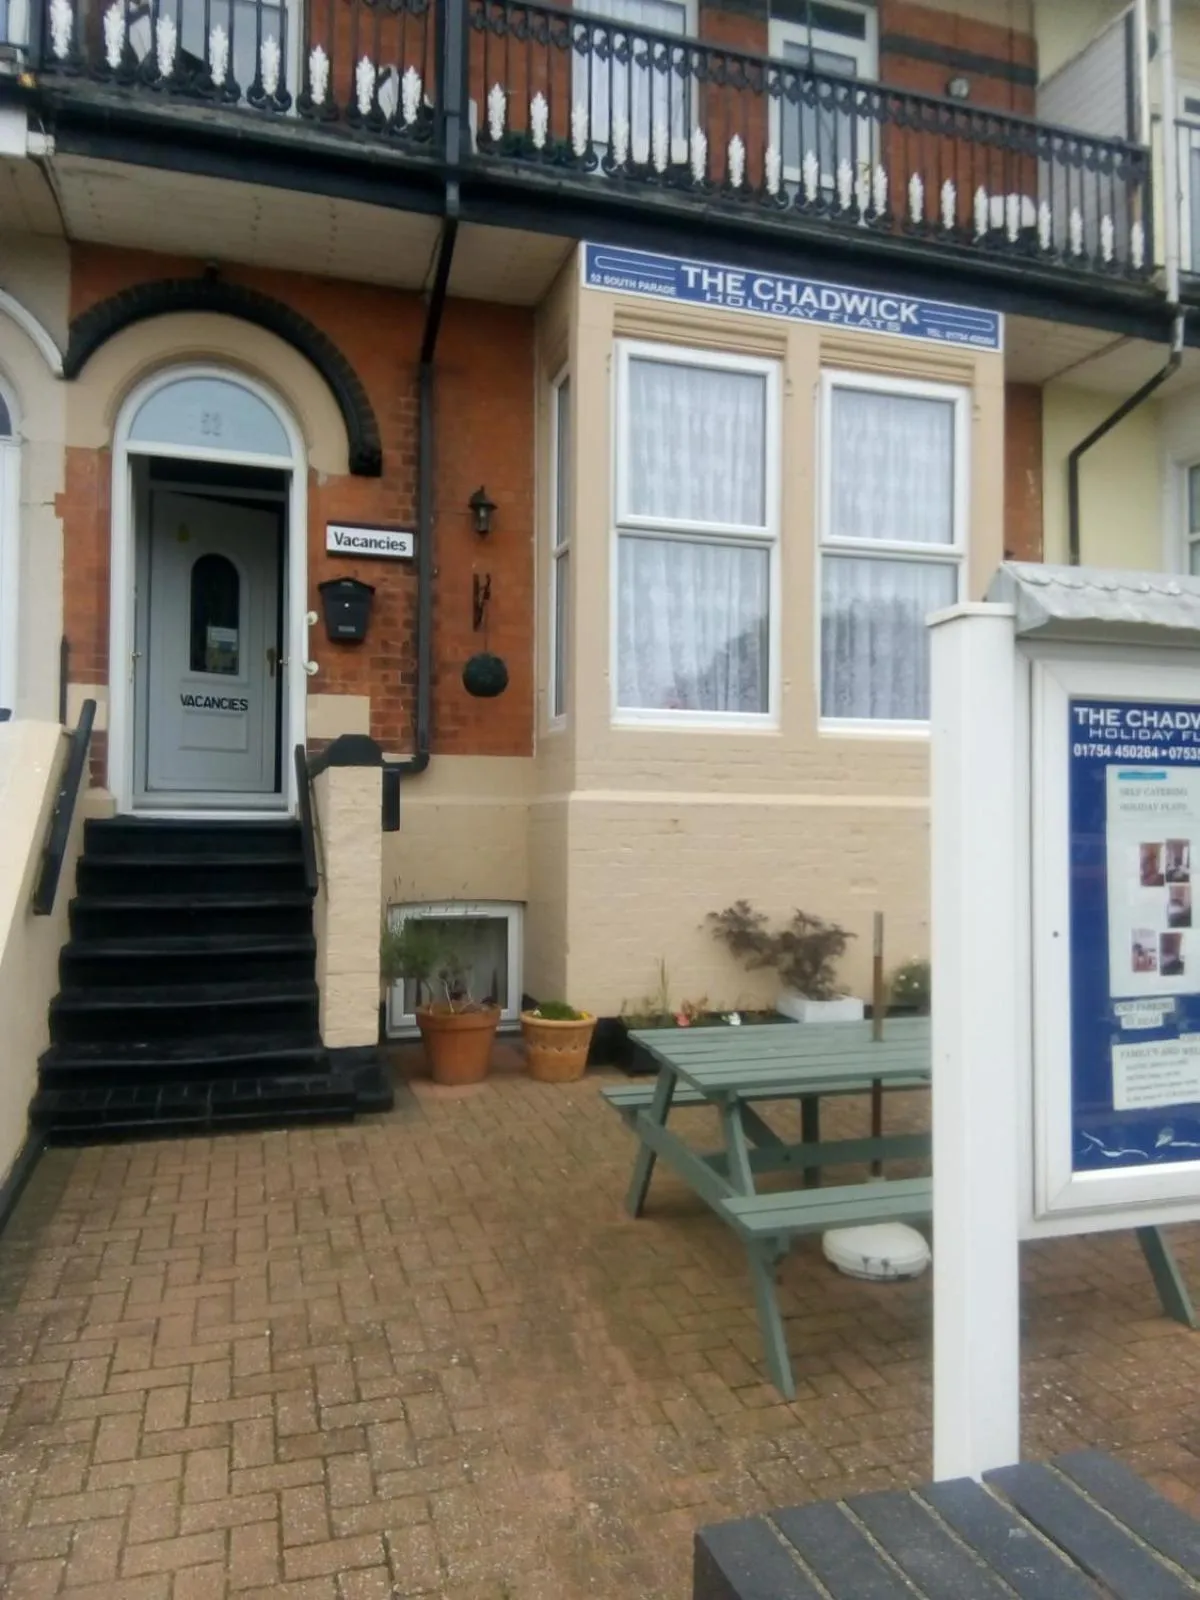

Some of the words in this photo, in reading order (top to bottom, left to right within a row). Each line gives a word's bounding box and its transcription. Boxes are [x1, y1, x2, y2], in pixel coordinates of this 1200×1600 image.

[603, 274, 637, 288] SOUTH
[638, 281, 677, 296] PARADE
[681, 265, 746, 296] THE
[753, 278, 919, 325] CHADWICK
[705, 292, 817, 319] HOLIDAY
[828, 312, 901, 332] FLATS
[333, 530, 407, 552] Vacancies
[180, 693, 249, 711] VACANCIES
[1073, 706, 1122, 727] THE
[1089, 727, 1174, 740] HOLIDAY
[1073, 743, 1111, 757] 01754
